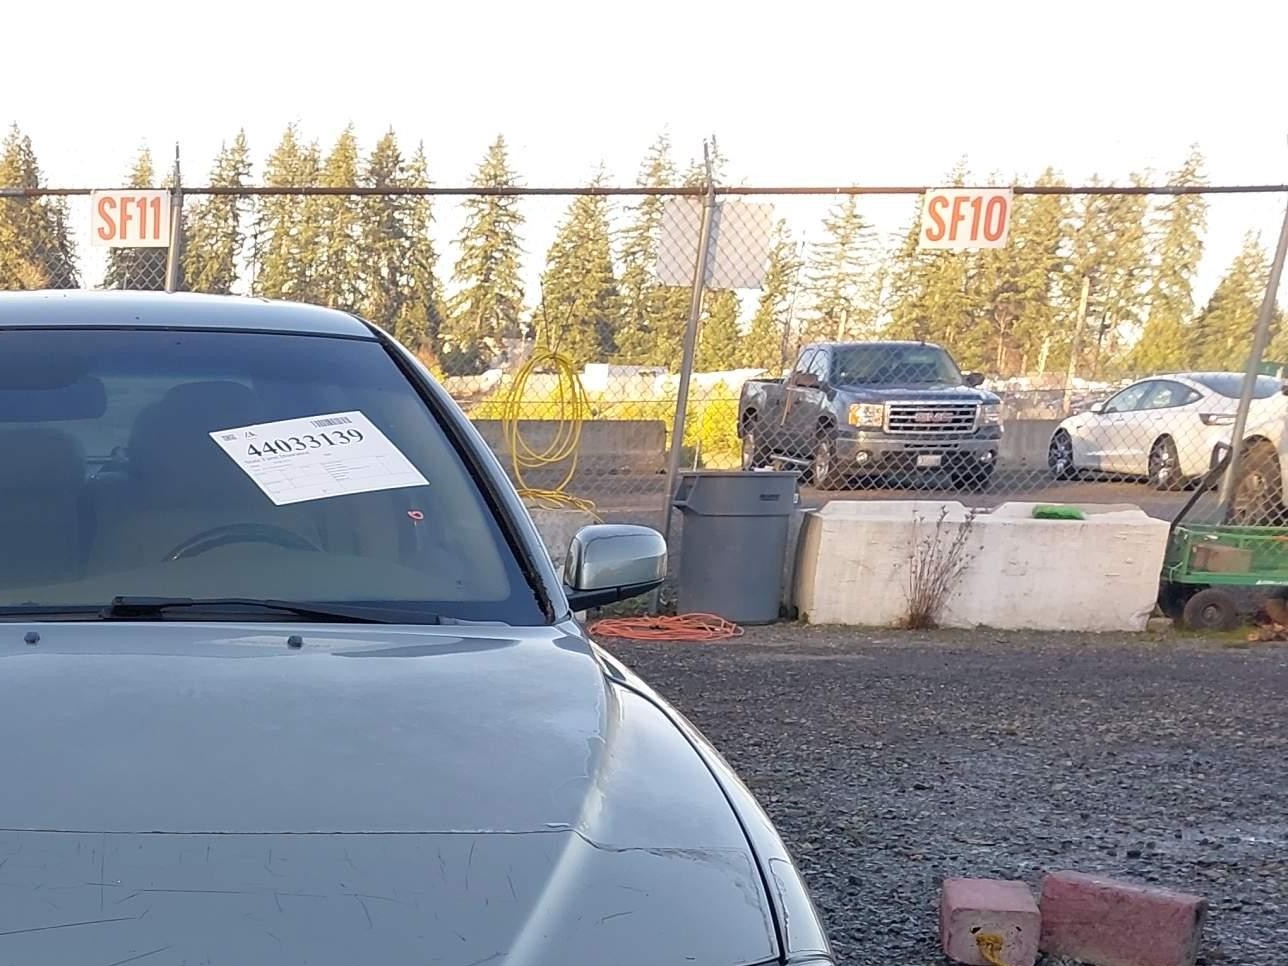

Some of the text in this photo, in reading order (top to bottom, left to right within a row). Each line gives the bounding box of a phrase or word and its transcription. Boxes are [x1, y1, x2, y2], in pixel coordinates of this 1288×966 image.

[97, 196, 161, 241] SF11
[925, 195, 1007, 242] SF10
[247, 428, 364, 457] 44033139
